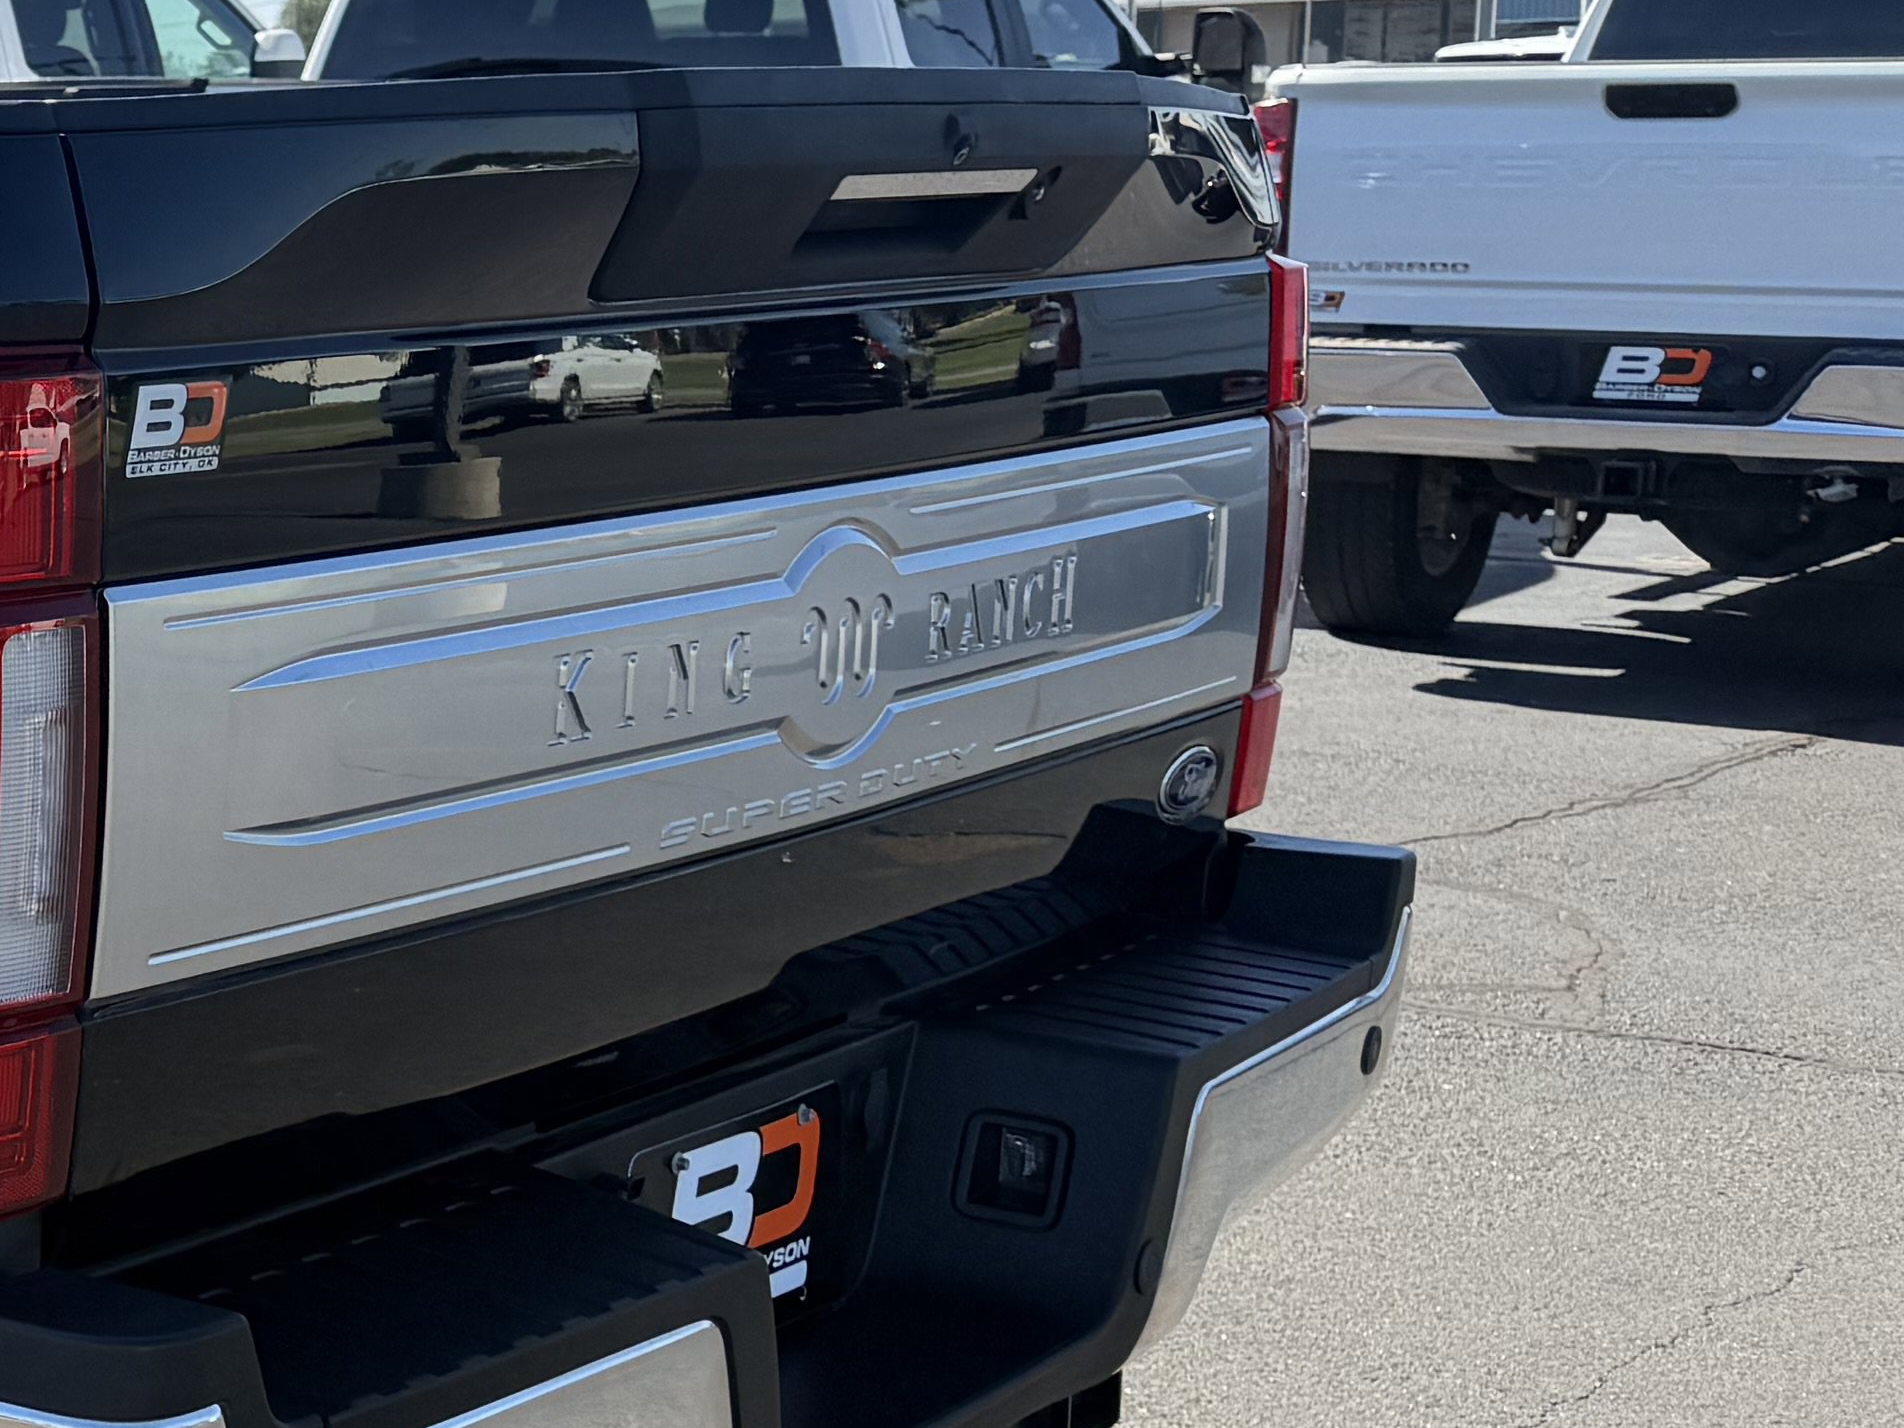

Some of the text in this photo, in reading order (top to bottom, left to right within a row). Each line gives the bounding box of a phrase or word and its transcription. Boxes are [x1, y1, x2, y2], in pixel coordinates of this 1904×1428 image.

[1599, 346, 1712, 385] BD
[130, 381, 228, 450] BD
[130, 465, 154, 475] ELK
[198, 458, 213, 469] OK
[547, 556, 1078, 747] KING RANCH
[659, 742, 978, 850] SUPER DUTY
[763, 1236, 811, 1268] YSON
